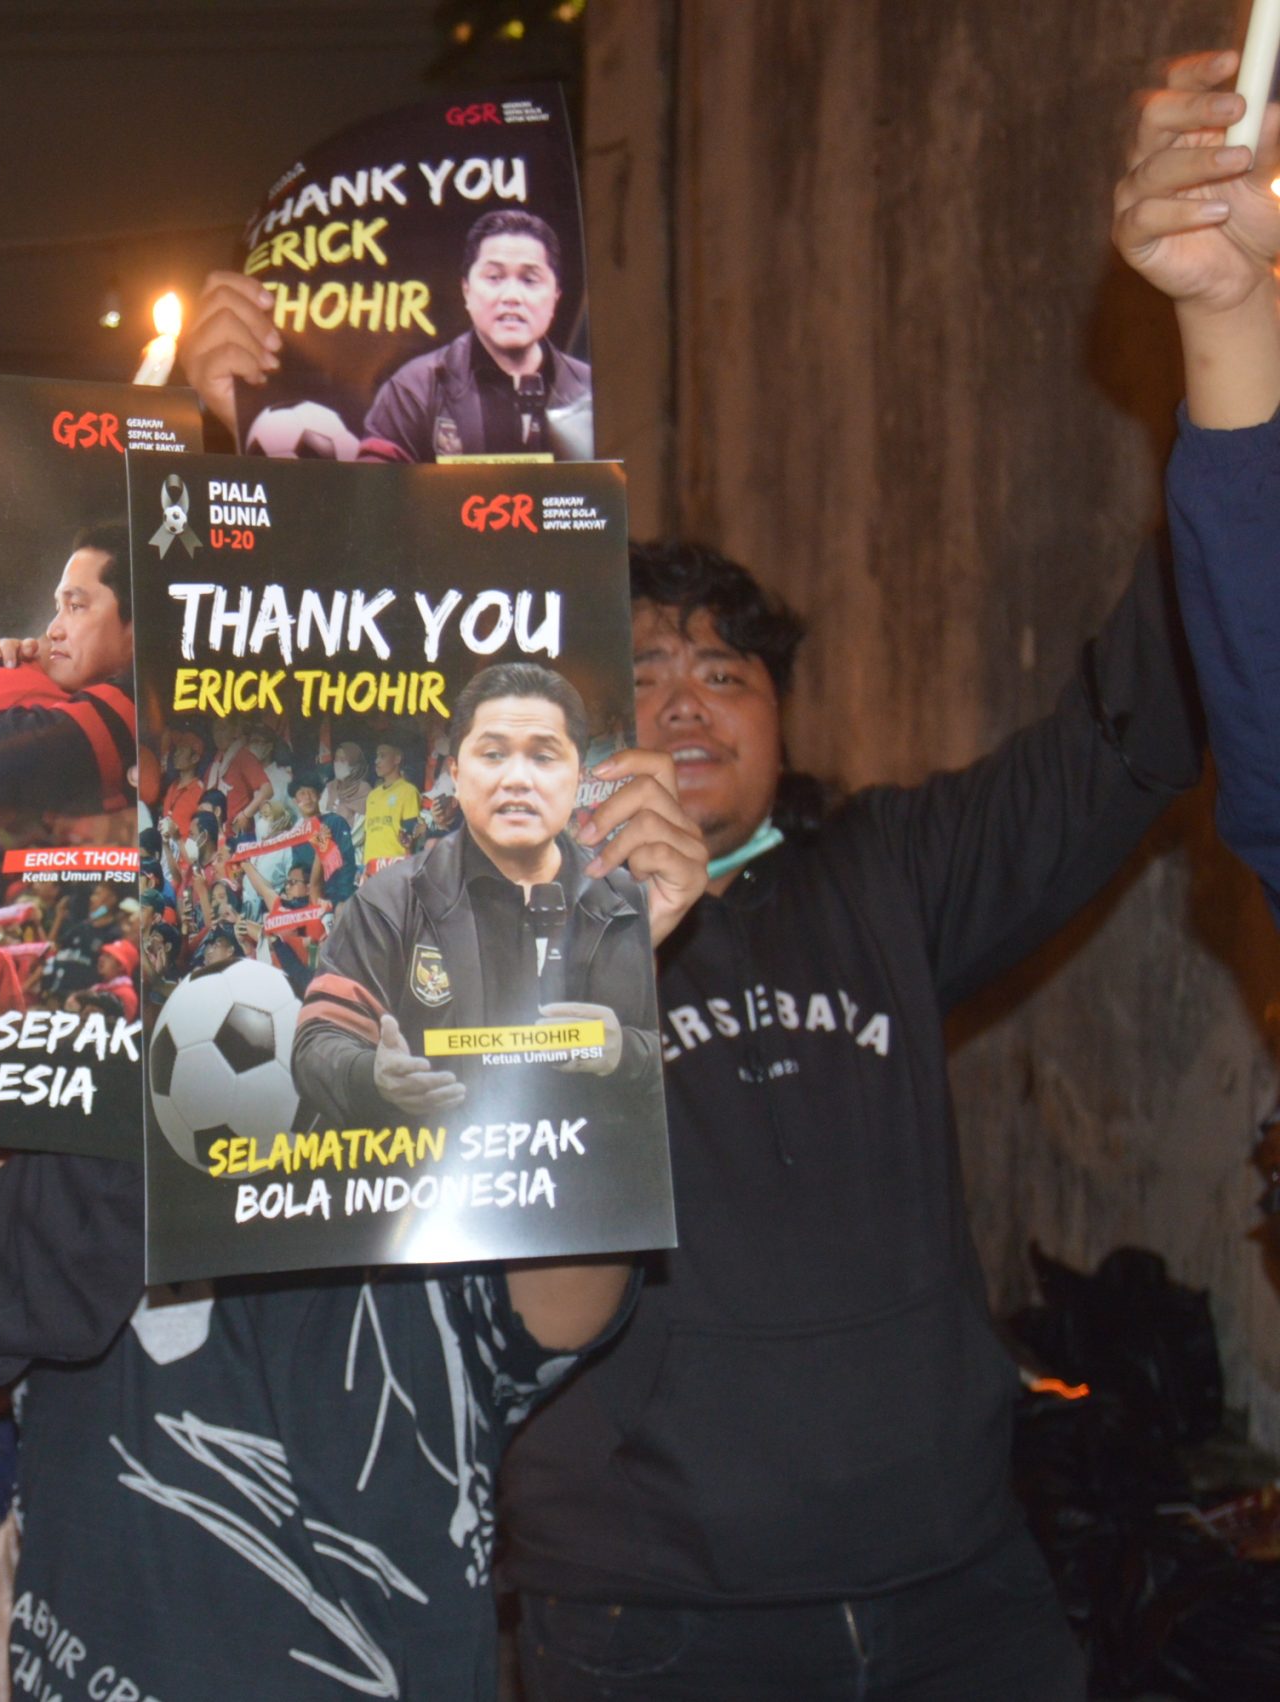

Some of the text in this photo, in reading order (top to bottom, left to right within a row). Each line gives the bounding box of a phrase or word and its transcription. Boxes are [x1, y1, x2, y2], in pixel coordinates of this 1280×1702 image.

[445, 102, 501, 127] GSR
[418, 158, 527, 206] YOU
[244, 217, 388, 276] ERICK
[262, 280, 437, 337] HOHIR
[52, 410, 125, 453] GSR
[126, 418, 164, 428] GERAKAN
[127, 430, 177, 442] SEPAK BOLA
[208, 481, 267, 504] PIALA
[542, 497, 584, 507] GERAKAN
[209, 504, 271, 527] DUNIA
[461, 494, 538, 533] GSR
[542, 508, 597, 518] SEPAK BOLA
[542, 519, 607, 530] UNTUK RAKYAT
[210, 528, 255, 550] U-20
[168, 583, 561, 665] THANK YOU
[173, 668, 451, 719] ERICK THOHIR
[24, 851, 139, 867] ERICK THOHI
[22, 871, 136, 883] Ketua Umum PSSI
[448, 1029, 580, 1049] ERICK THOHIR
[482, 1047, 603, 1065] Ketua Umum PSSI
[208, 1117, 588, 1177] SELAMATKAN SEPAK
[234, 1167, 557, 1224] BOLA INDONESIA
